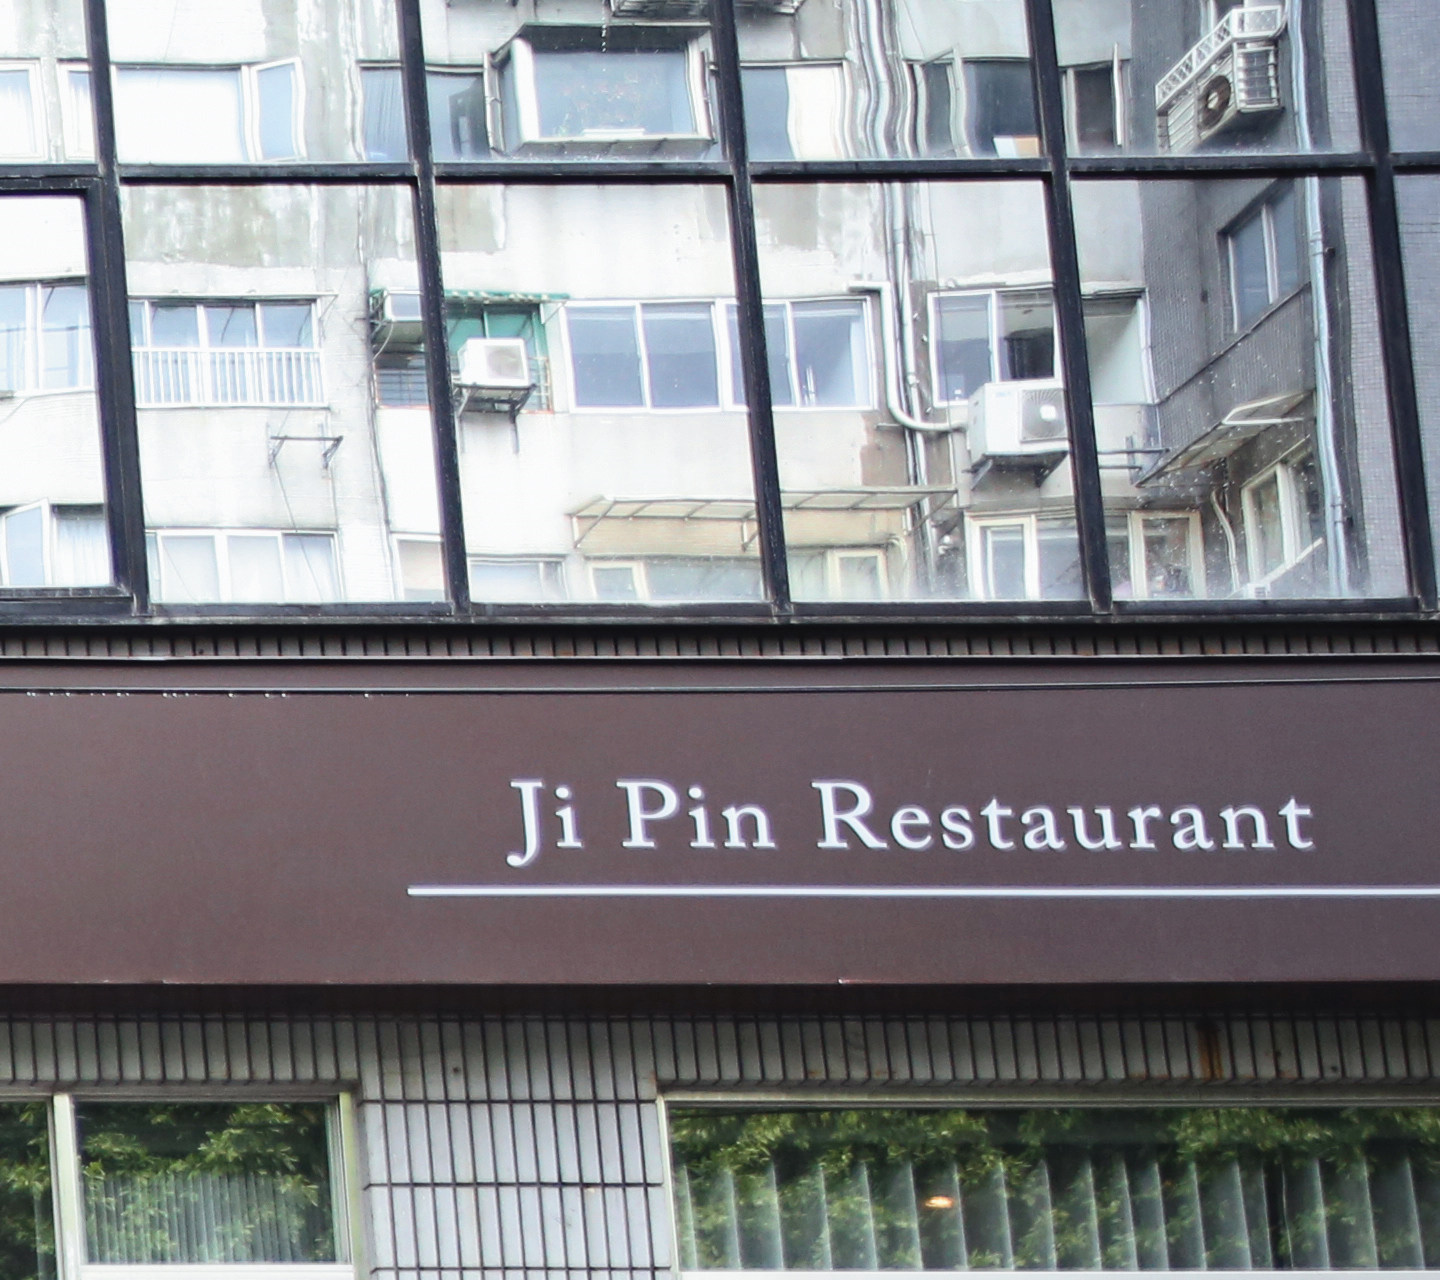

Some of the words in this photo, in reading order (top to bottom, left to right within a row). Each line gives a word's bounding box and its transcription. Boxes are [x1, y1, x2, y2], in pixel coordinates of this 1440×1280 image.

[507, 777, 584, 867] Ji
[617, 779, 777, 852] Pin
[812, 779, 1314, 852] Restaurant
